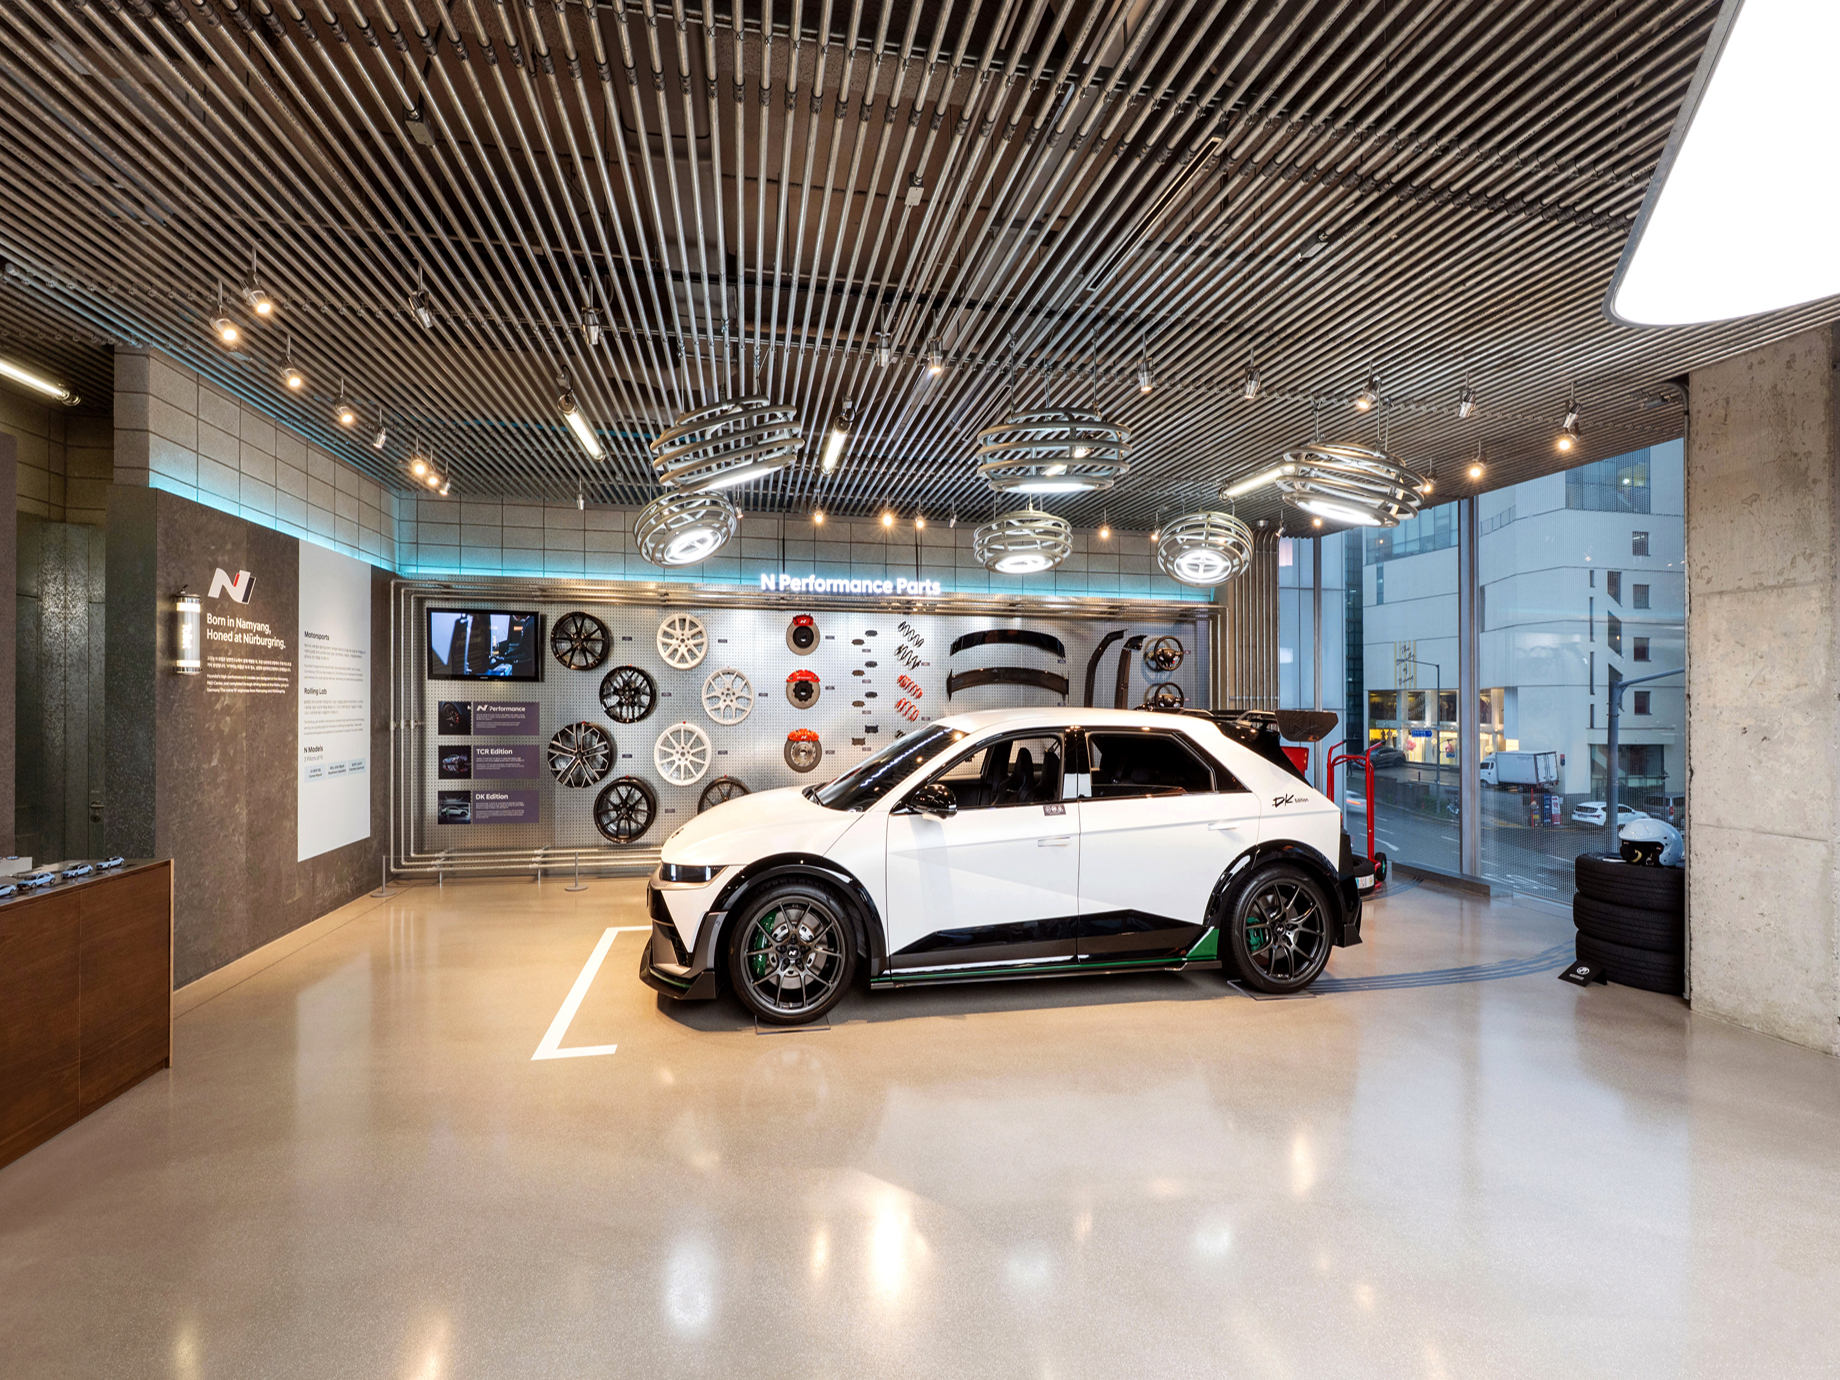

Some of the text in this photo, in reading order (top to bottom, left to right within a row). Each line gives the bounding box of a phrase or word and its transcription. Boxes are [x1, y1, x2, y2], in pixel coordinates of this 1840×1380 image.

[760, 573, 942, 595] N Performance Parts
[206, 612, 272, 635] Born in Namyang,
[206, 628, 233, 642] Honed
[234, 632, 242, 643] at
[304, 631, 330, 641] Motorsports
[304, 687, 319, 696] Rolling
[304, 745, 324, 754] N Models
[1272, 793, 1294, 808] DK
